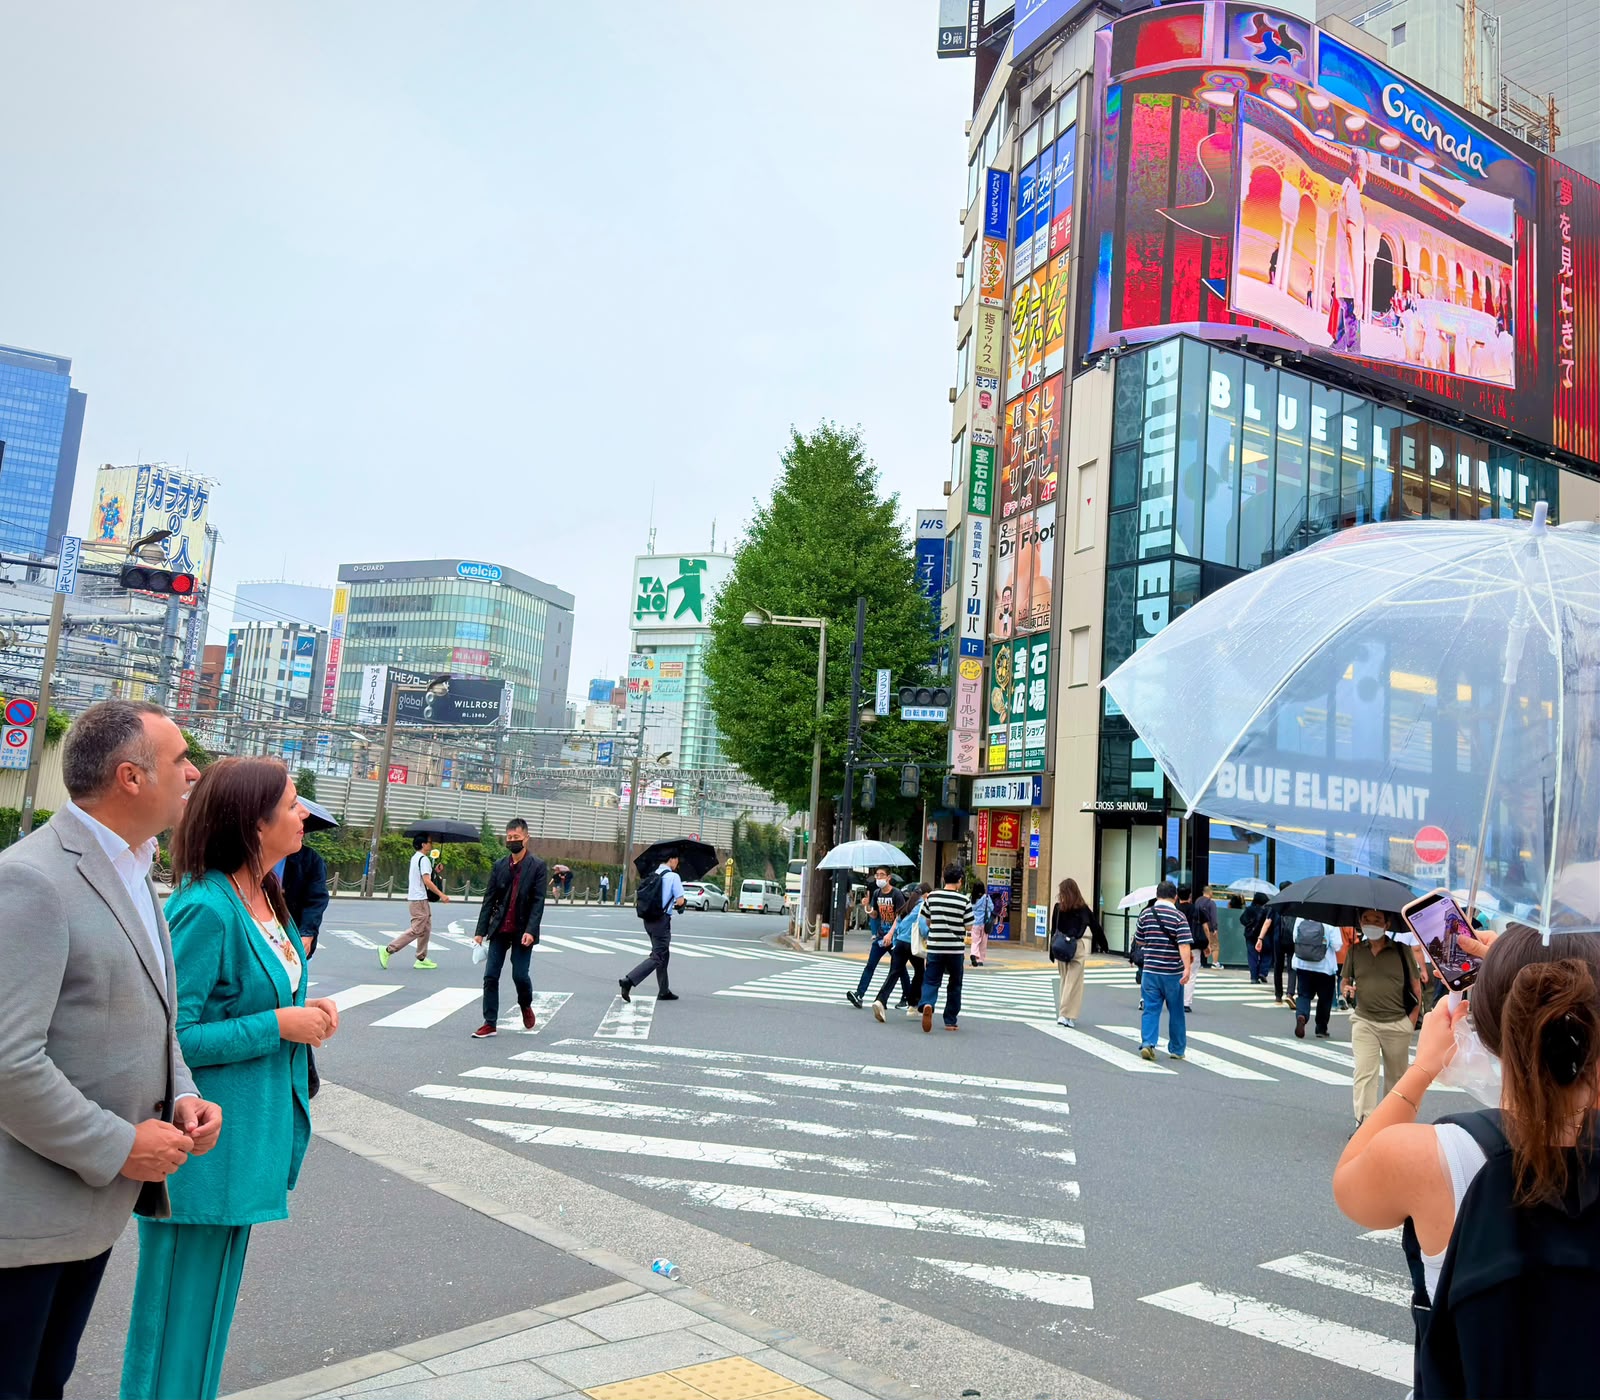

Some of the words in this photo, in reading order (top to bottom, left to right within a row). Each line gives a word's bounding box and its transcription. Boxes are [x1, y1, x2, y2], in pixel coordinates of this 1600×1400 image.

[1382, 81, 1488, 179] Granada
[1058, 251, 1070, 271] 5F
[1558, 176, 1575, 389] 夢を見にきて
[982, 312, 996, 364] 指ラックス
[1141, 340, 1180, 489] BLUE
[1011, 418, 1053, 462] アロマ
[1209, 370, 1328, 441] BLUE
[1341, 415, 1530, 506] ELEPHANT
[973, 448, 989, 512] 宝石広場
[1009, 453, 1052, 495] リフレ
[1041, 480, 1058, 501] 4F
[147, 469, 209, 521] カラオケ
[167, 511, 181, 537] の
[972, 521, 982, 559] 高価買取
[999, 539, 1016, 558] Dr
[1021, 522, 1055, 550] Foot
[58, 538, 77, 592] スクランブル式
[353, 564, 385, 572] O-GUARD
[460, 562, 499, 579] welcia
[636, 594, 667, 611] NO
[639, 576, 665, 593] TA
[967, 562, 983, 634] ブラリバ
[967, 641, 978, 653] 1F
[1013, 642, 1048, 680] 宝石
[399, 695, 424, 710] global
[454, 700, 499, 709] WILLROSE
[878, 672, 887, 714] スクランブル式
[1012, 678, 1047, 715] 広場
[904, 709, 945, 718] 自転車専用
[985, 785, 1007, 799] 高価買取
[1034, 783, 1041, 798] 1F
[1094, 801, 1115, 811] CROSS
[1116, 801, 1148, 811] SHINJUKU
[1215, 761, 1290, 806] BLUE
[1295, 770, 1430, 822] ELEPHANT
